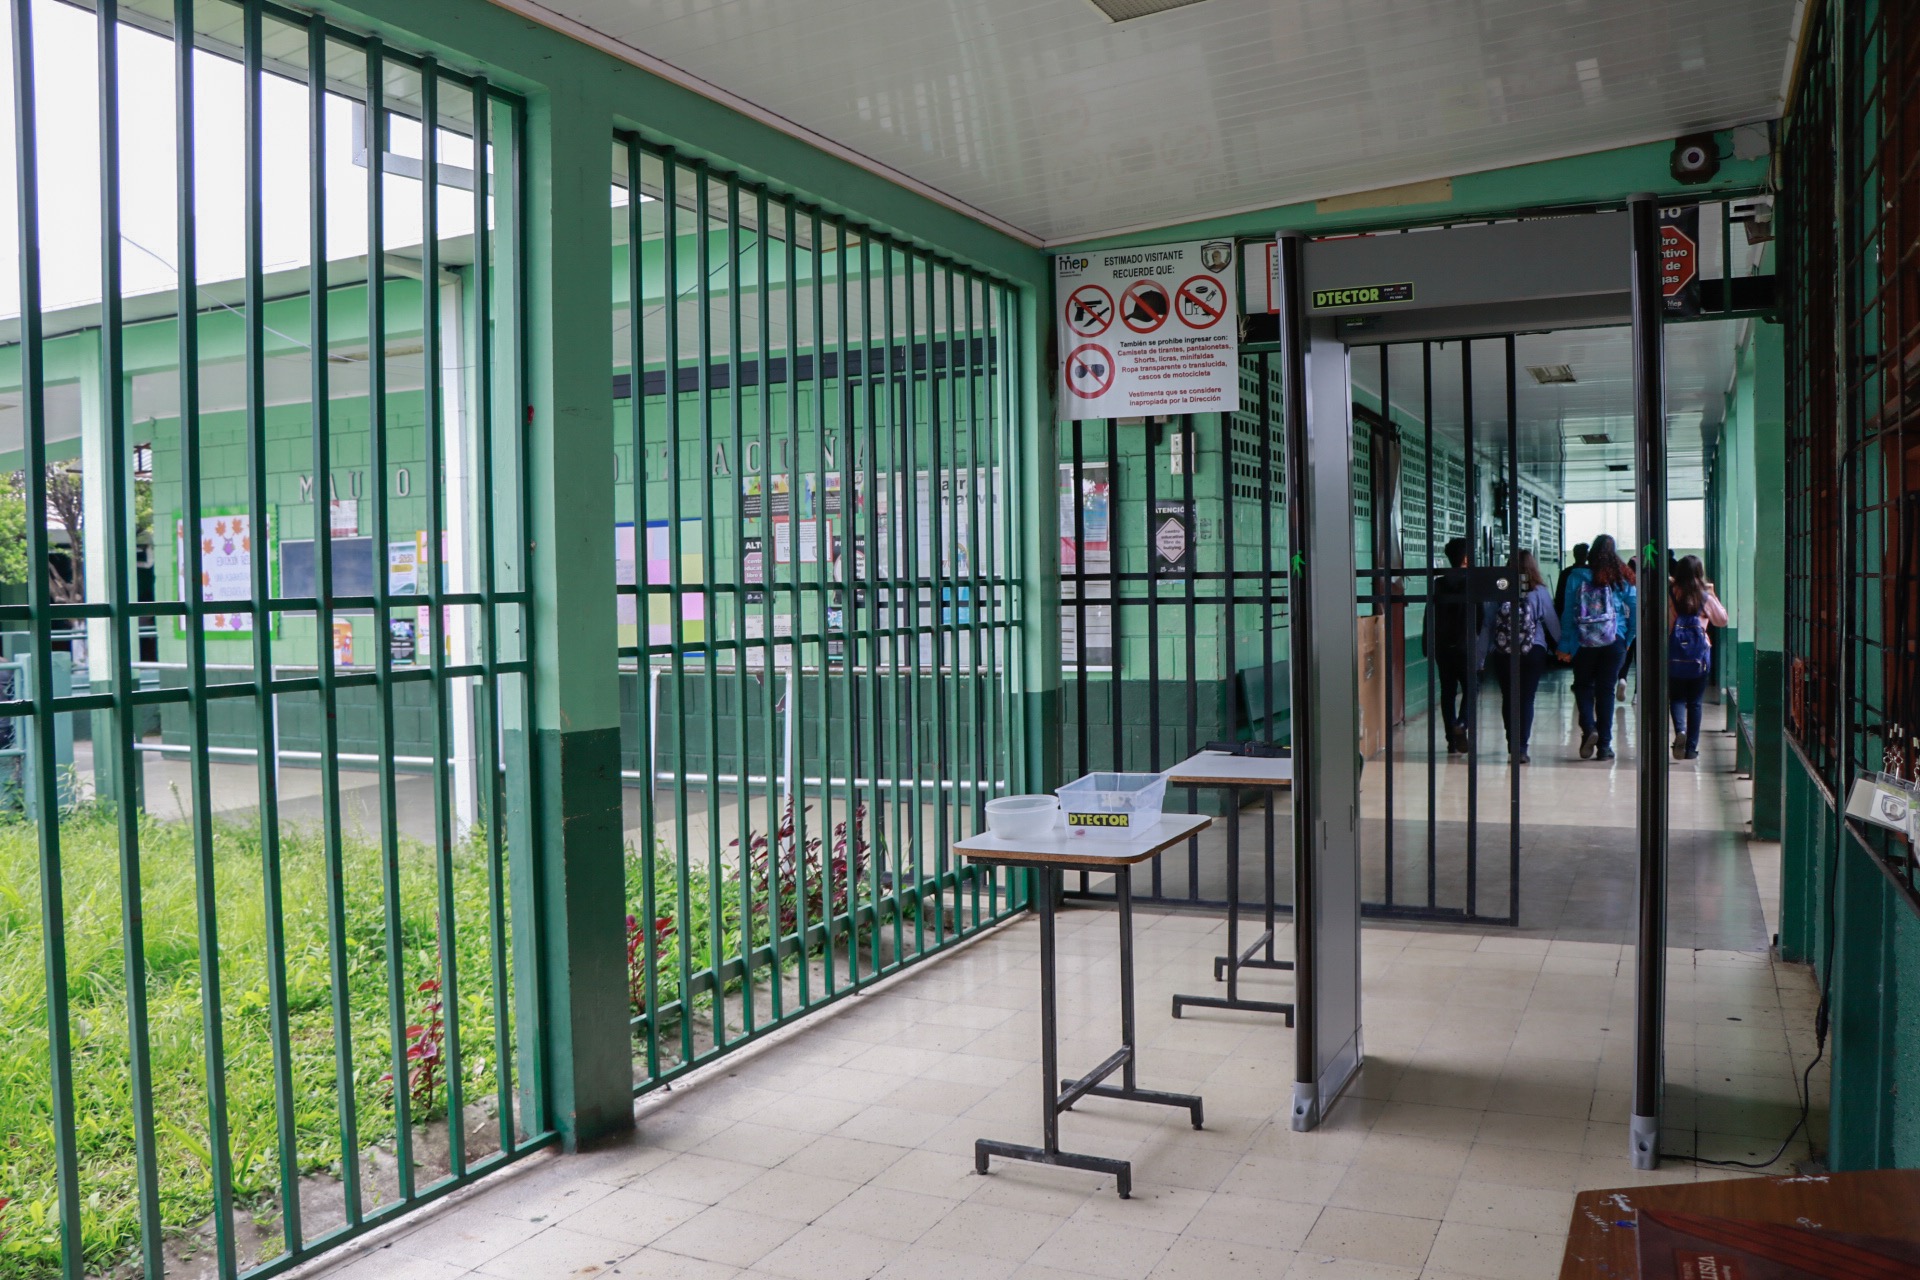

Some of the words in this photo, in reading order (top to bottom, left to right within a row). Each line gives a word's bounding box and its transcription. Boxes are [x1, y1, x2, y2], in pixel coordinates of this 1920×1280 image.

[1661, 237, 1678, 245] tro
[1058, 256, 1089, 272] mep
[1104, 254, 1143, 267] ESTIMADO
[1145, 251, 1183, 262] VISITANTE
[1113, 267, 1155, 279] RECUERDE
[1156, 265, 1175, 276] QUE:
[1317, 288, 1379, 305] DTECTOR
[1120, 339, 1147, 348] También
[1184, 336, 1212, 345] ingresar
[1180, 352, 1214, 360] minifaldas
[1122, 366, 1138, 374] Ropa
[1140, 363, 1181, 372] transparente
[1172, 370, 1211, 378] motocicleta
[1128, 389, 1164, 397] Vestimenta
[1165, 389, 1178, 397] que
[1188, 386, 1222, 394] considere
[1130, 398, 1168, 406] inapropiada
[1169, 397, 1180, 405] por
[1189, 395, 1221, 403] Dirección
[298, 468, 411, 504] MAUO
[1155, 506, 1184, 514] ATENCIÓ
[1068, 813, 1128, 826] DTECTOR
